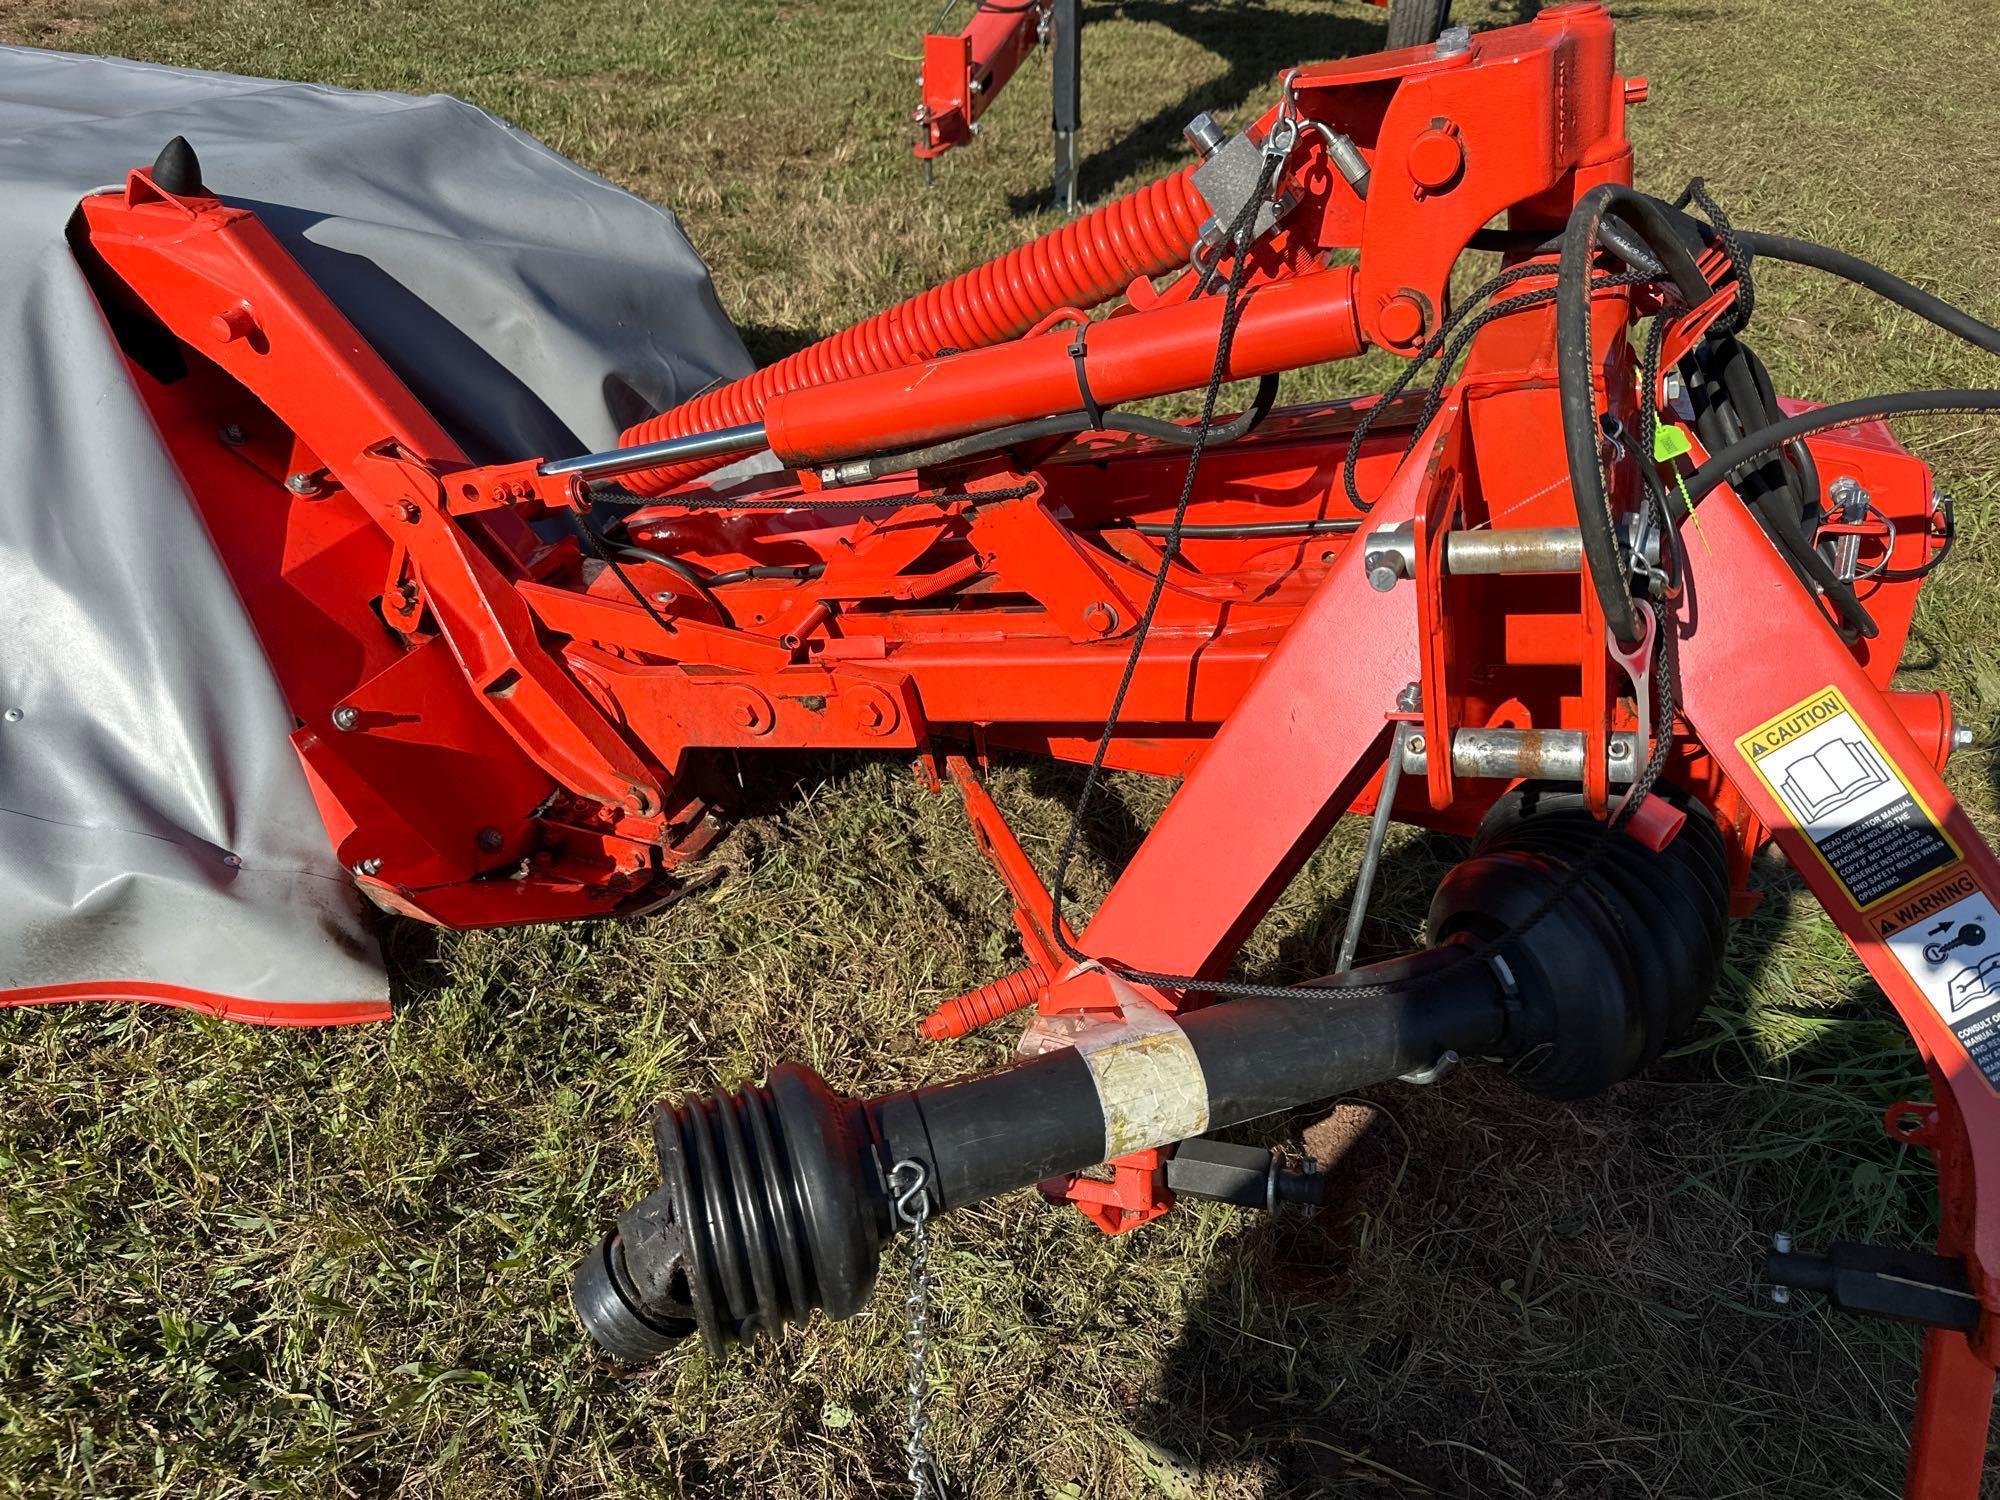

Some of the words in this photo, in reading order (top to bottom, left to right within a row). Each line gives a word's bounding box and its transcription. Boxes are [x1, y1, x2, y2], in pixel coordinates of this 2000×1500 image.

[1766, 698, 1839, 746] CAUTION
[1821, 838, 1842, 852] READ
[1842, 815, 1882, 841] OPERATOR
[1880, 800, 1913, 820] MANUAL
[1827, 841, 1857, 861] BEFORE
[1858, 821, 1895, 847] HANDLING
[1893, 811, 1911, 825] THE
[1867, 827, 1901, 850] REQUEST
[1903, 824, 1910, 832] A
[1840, 862, 1860, 877] COPY
[1861, 858, 1868, 867] IF
[1867, 849, 1884, 862] NOT
[1846, 862, 1880, 885] OBSERVE
[1880, 835, 1934, 867] INSTRUCTIONS
[1852, 881, 1869, 893] AND
[1868, 866, 1897, 886] SAFETY
[1896, 851, 1922, 870] RULES
[1920, 840, 1945, 857] WHEN
[1894, 877, 1974, 924] WARNING
[1958, 1017, 1993, 1039] CONSULT
[1971, 1044, 1988, 1056] AND
[1978, 1052, 1993, 1064] ANY
